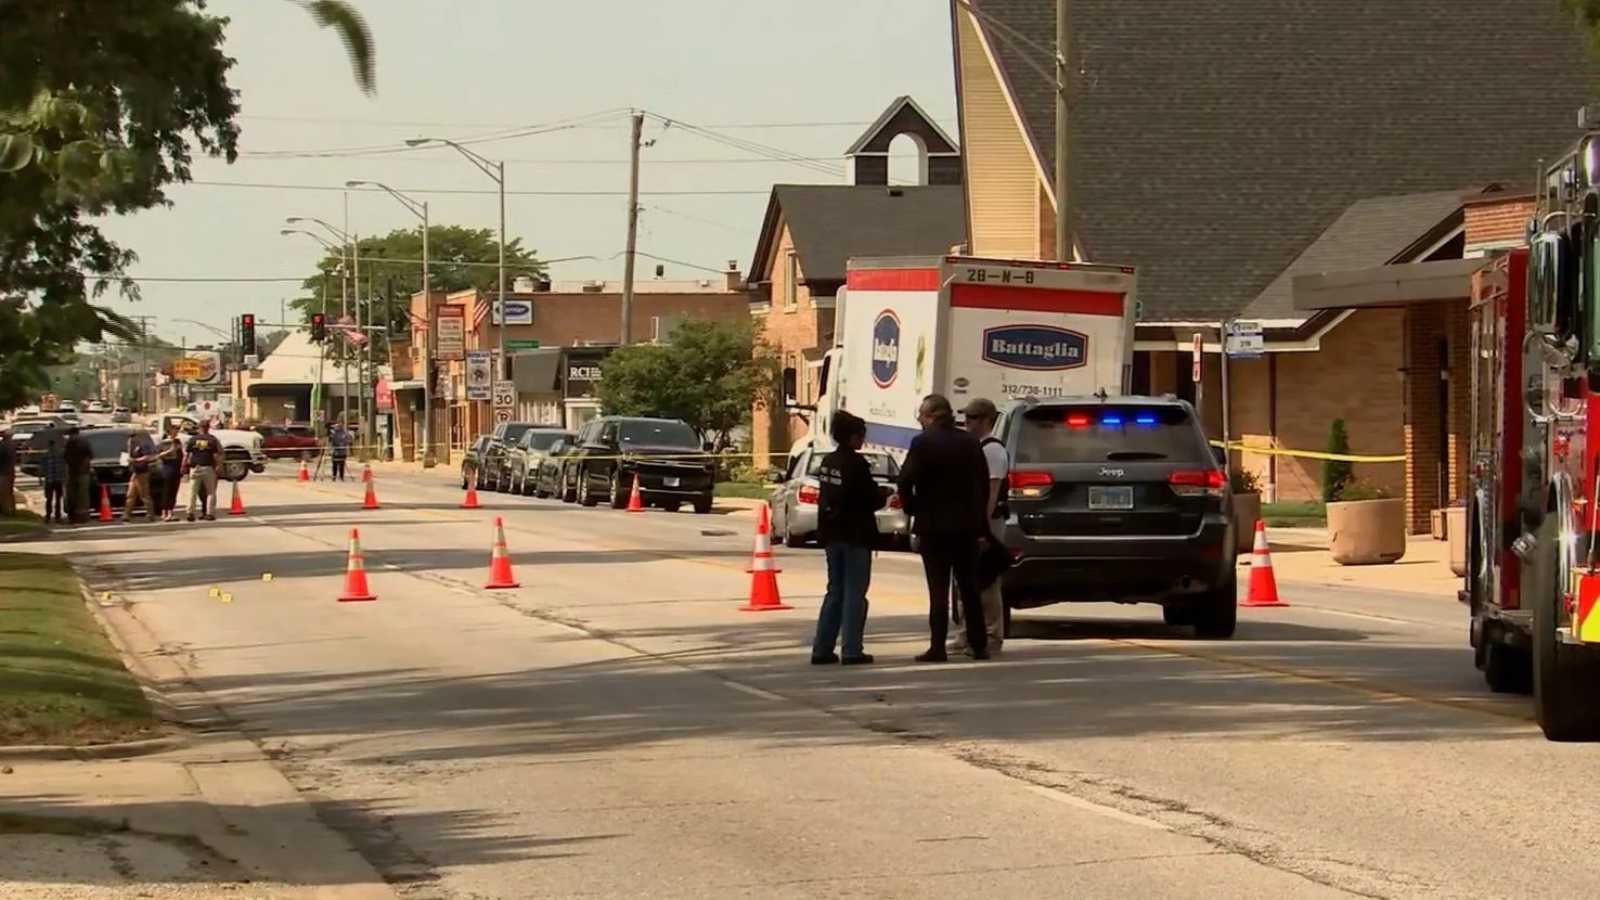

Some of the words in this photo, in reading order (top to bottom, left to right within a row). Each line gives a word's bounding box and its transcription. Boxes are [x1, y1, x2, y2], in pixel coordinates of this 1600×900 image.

[992, 339, 1079, 360] Battaglia
[570, 367, 590, 377] RCI
[496, 394, 513, 405] 30
[1098, 465, 1125, 478] Jeep
